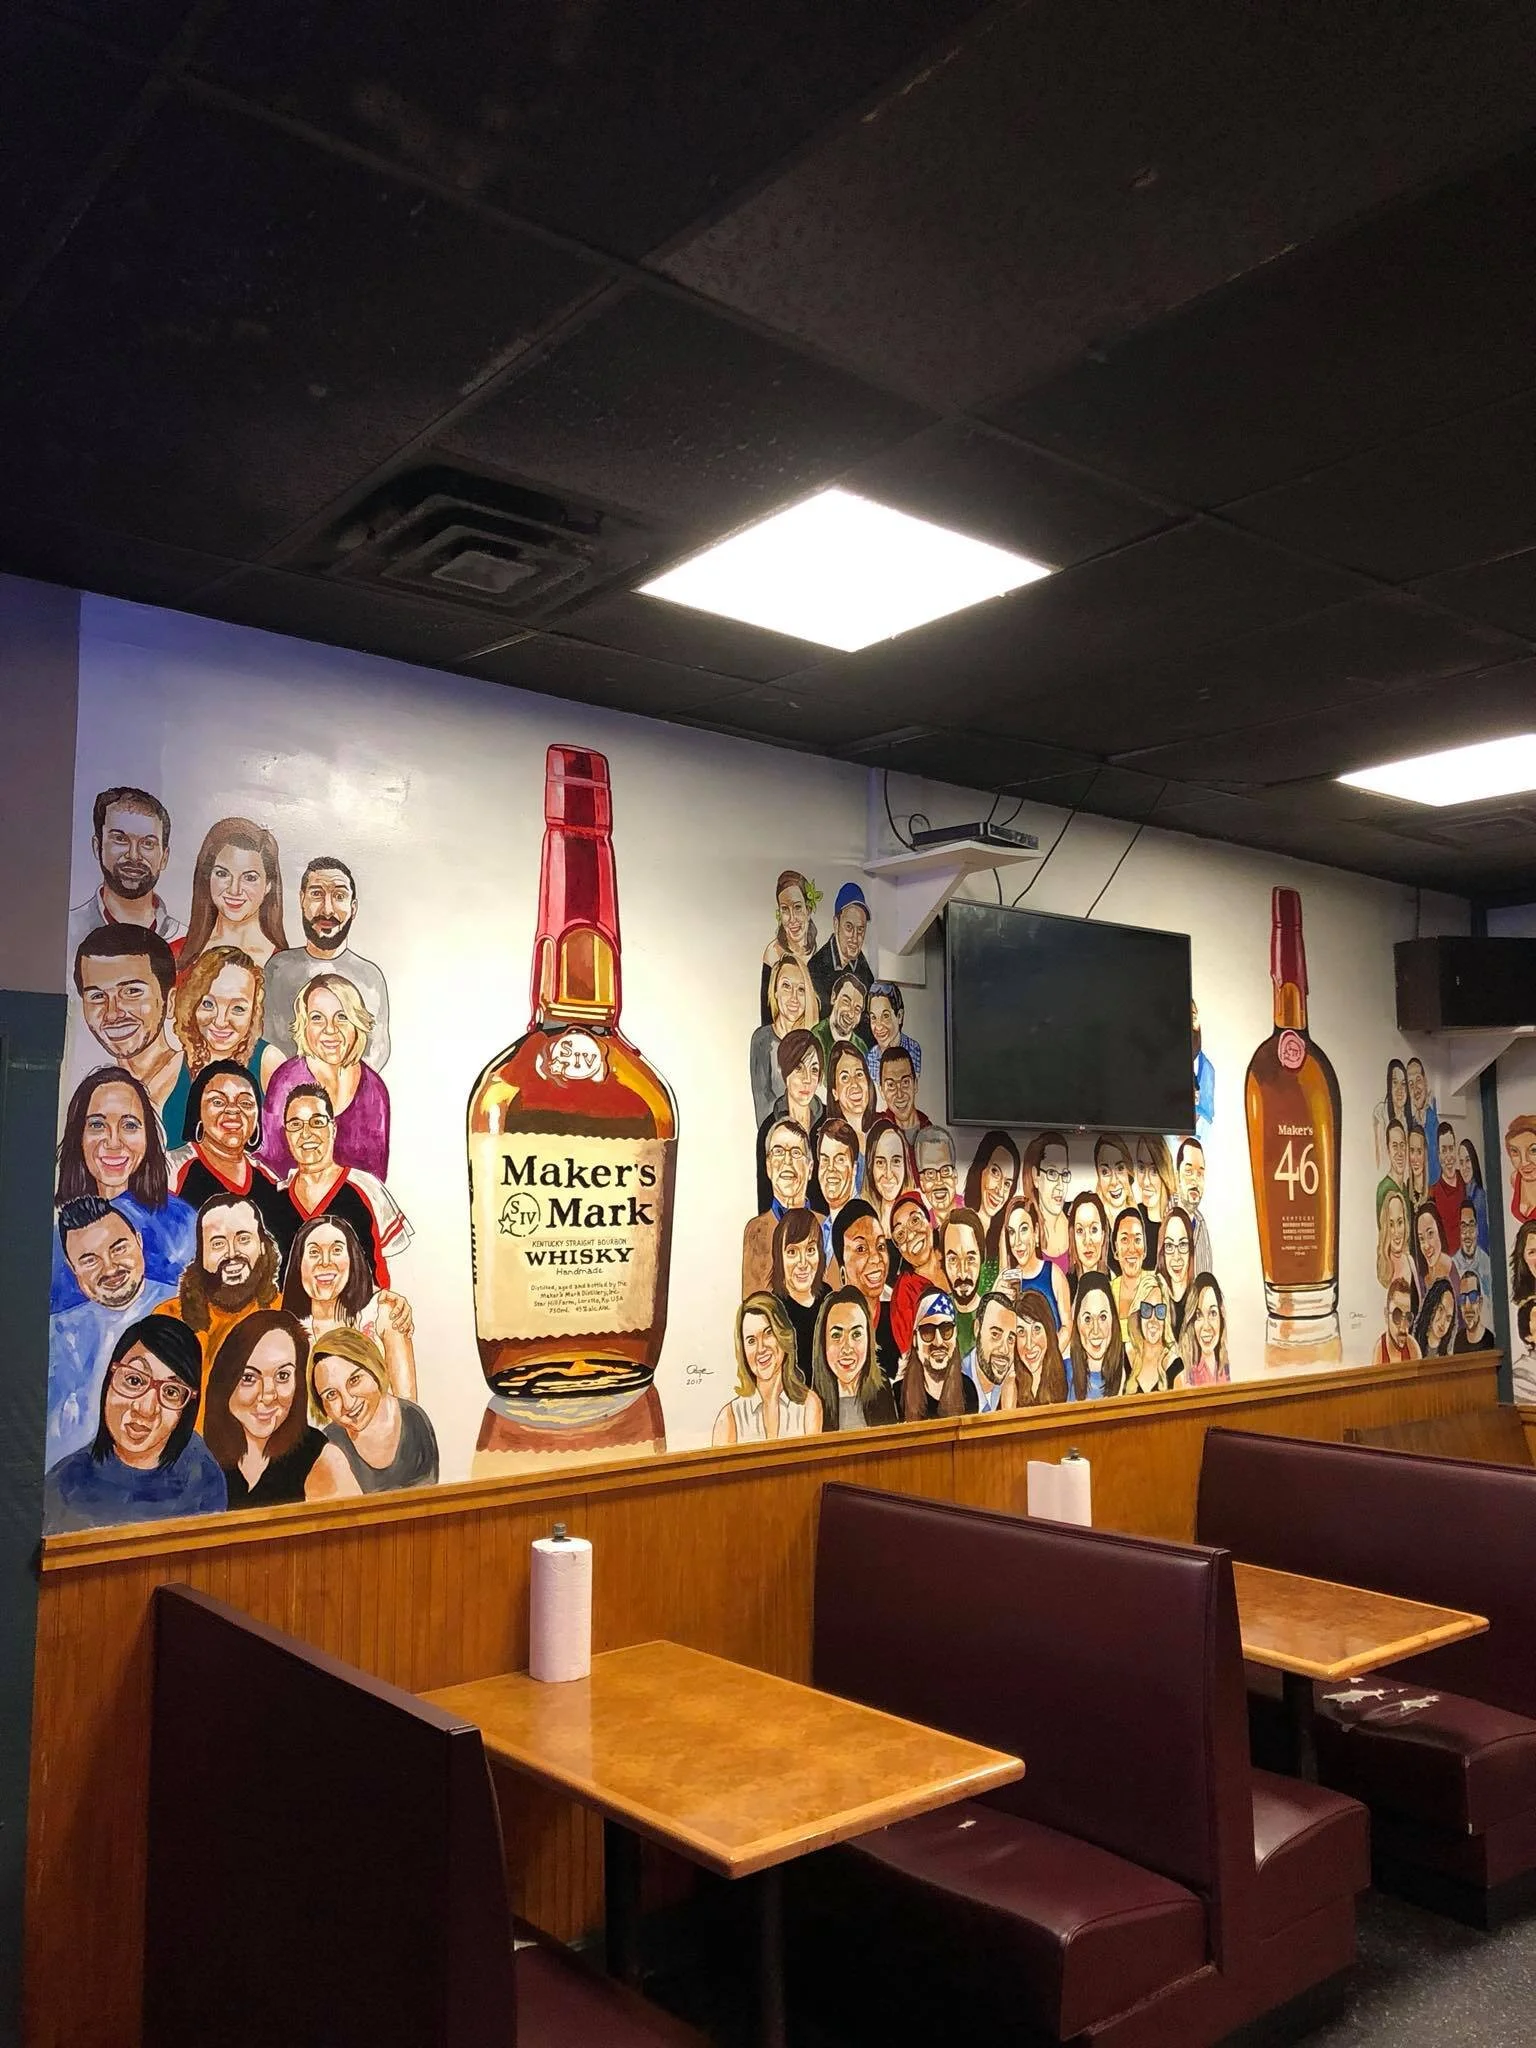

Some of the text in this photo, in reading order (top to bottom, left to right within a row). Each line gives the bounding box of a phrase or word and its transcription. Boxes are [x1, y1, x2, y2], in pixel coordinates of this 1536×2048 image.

[574, 1052, 597, 1068] IV
[1278, 1124, 1313, 1136] Maker's
[500, 1155, 656, 1189] Maker's
[1274, 1140, 1319, 1201] 46
[510, 1201, 520, 1214] S
[545, 1196, 654, 1228] Mark
[520, 1211, 537, 1225] IV
[532, 1238, 627, 1248] KENTUCKY STRAIGHT BOURBON
[524, 1247, 635, 1266] WHISKY
[556, 1267, 604, 1275] Handmade
